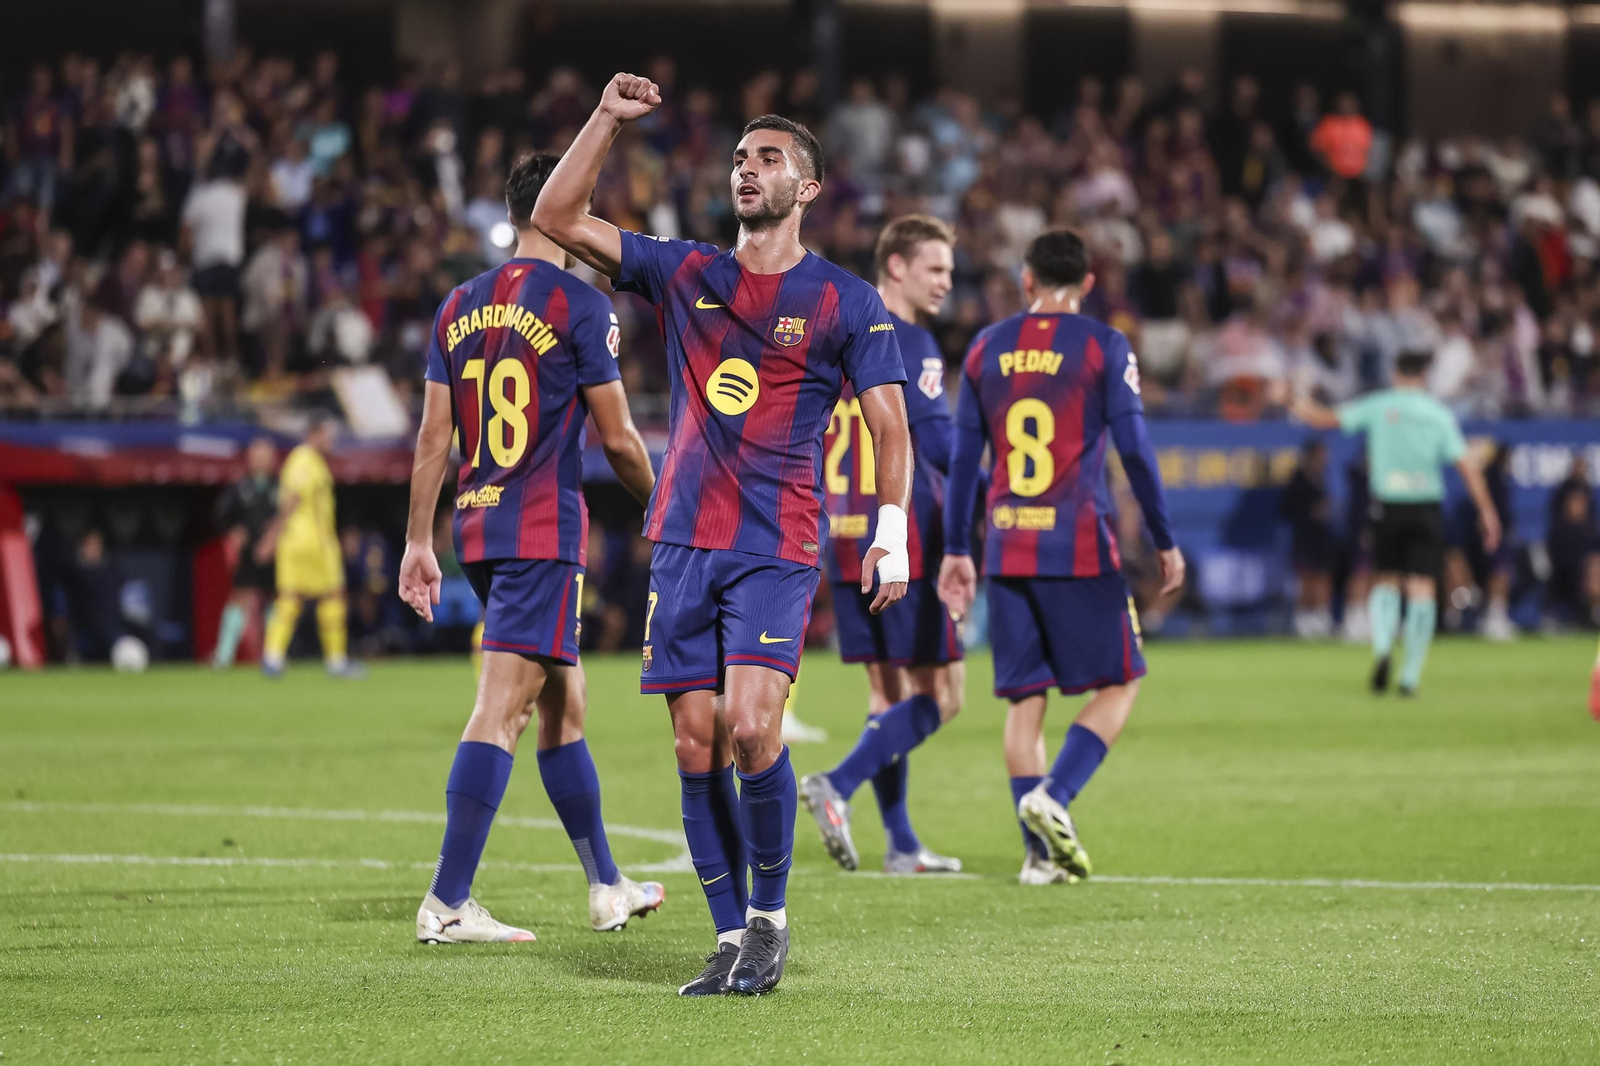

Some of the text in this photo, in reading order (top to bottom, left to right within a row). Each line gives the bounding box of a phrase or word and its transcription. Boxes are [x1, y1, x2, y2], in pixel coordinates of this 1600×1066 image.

[998, 349, 1064, 377] PEDRI
[461, 357, 530, 468] 18
[824, 397, 877, 495] 21
[1005, 397, 1055, 497] 8
[644, 592, 658, 640] 7
